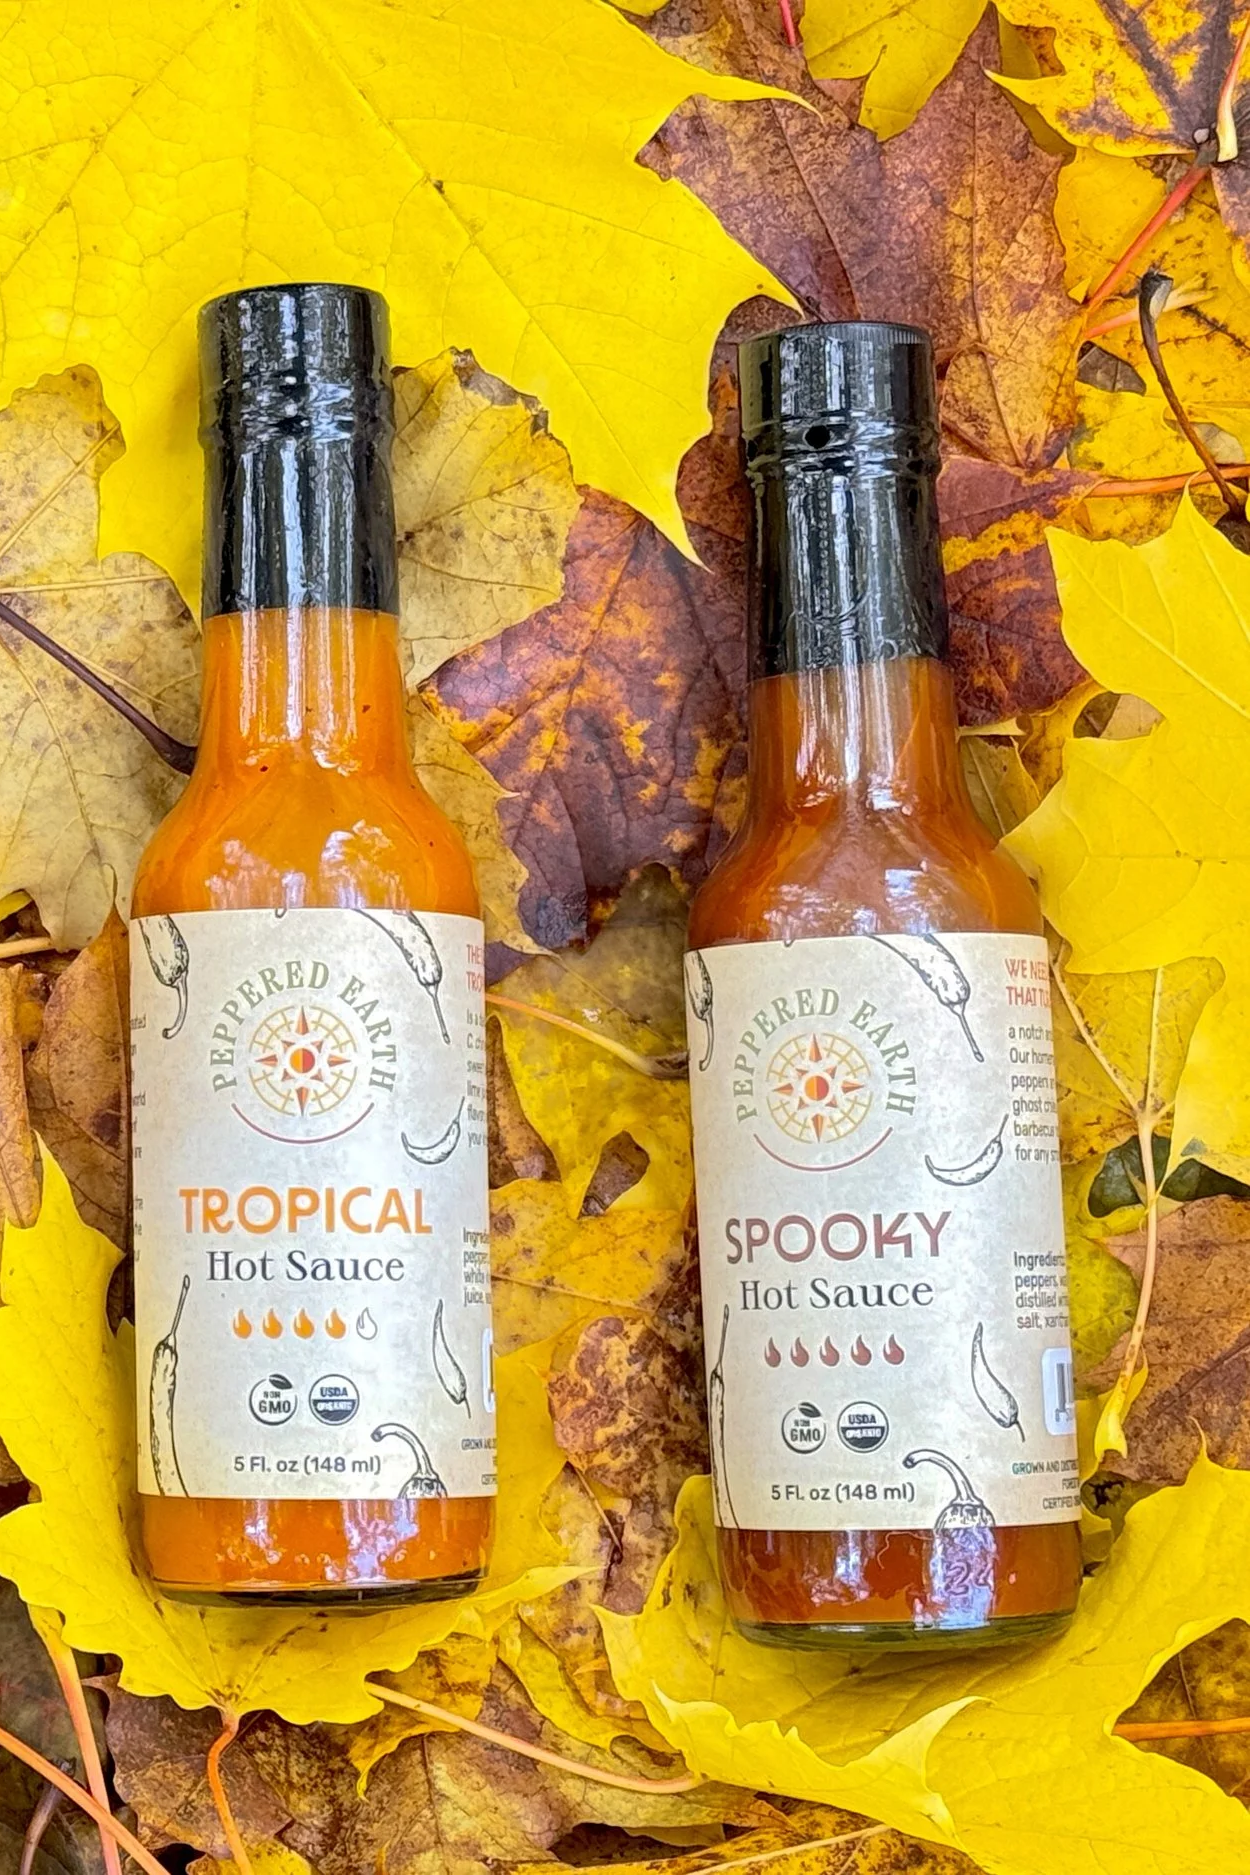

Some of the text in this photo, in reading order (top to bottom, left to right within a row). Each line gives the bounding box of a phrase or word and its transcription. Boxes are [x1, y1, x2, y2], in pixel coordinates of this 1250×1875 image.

[1004, 958, 1027, 979] WE
[210, 960, 397, 1093] PEPPERED EARTH
[1008, 1026, 1016, 1040] a
[732, 988, 917, 1123] PEPPERED EARTH
[1010, 1047, 1030, 1064] Our
[1012, 1096, 1042, 1117] ghost
[1014, 1144, 1032, 1161] for
[178, 1186, 433, 1235] TROPICAL
[725, 1210, 952, 1265] SPOOKY
[205, 1249, 405, 1282] Hot Sauce
[739, 1277, 935, 1311] Hot Sauce
[1015, 1291, 1056, 1309] distilled
[319, 1386, 348, 1398] USDA
[258, 1400, 291, 1414] GMO
[847, 1413, 877, 1425] USDA
[790, 1428, 821, 1443] GMO
[233, 1454, 381, 1475] 5 Fl. oz (148 ml)
[1012, 1462, 1044, 1475] GROWN
[770, 1481, 915, 1503] 5 Fl. oz (148 ml)
